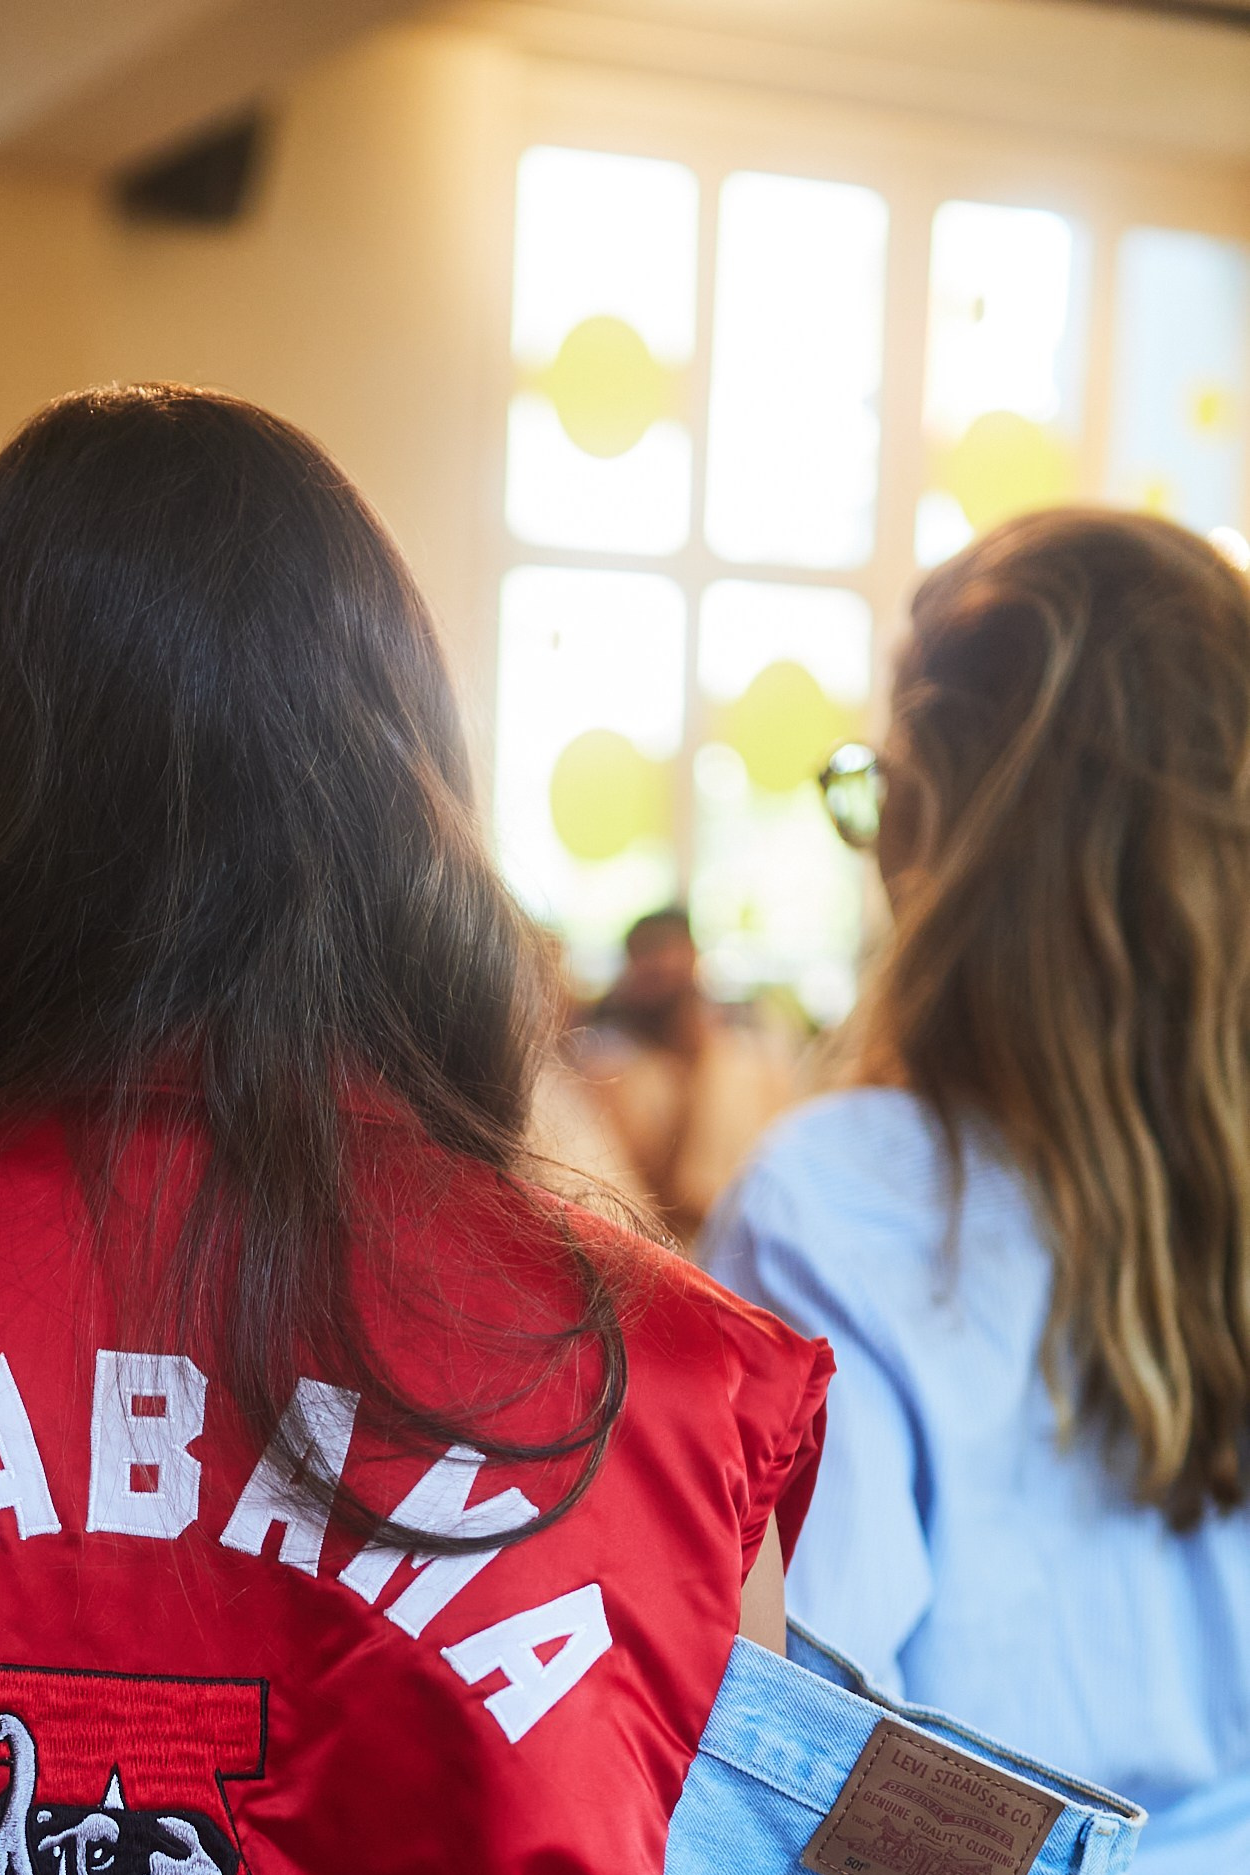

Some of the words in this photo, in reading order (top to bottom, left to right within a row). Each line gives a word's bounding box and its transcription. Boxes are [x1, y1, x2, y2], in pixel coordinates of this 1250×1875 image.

[888, 1782, 945, 1820] ORIGINAL
[953, 1815, 1012, 1844] RIVETED
[891, 1748, 929, 1779] LEVI
[930, 1769, 998, 1809] STRAUSS
[996, 1802, 1009, 1818] &
[1010, 1808, 1033, 1829] CO.
[862, 1789, 911, 1821] GENUINE
[913, 1815, 964, 1845] QUALITY
[966, 1839, 1015, 1868] CLOTHING
